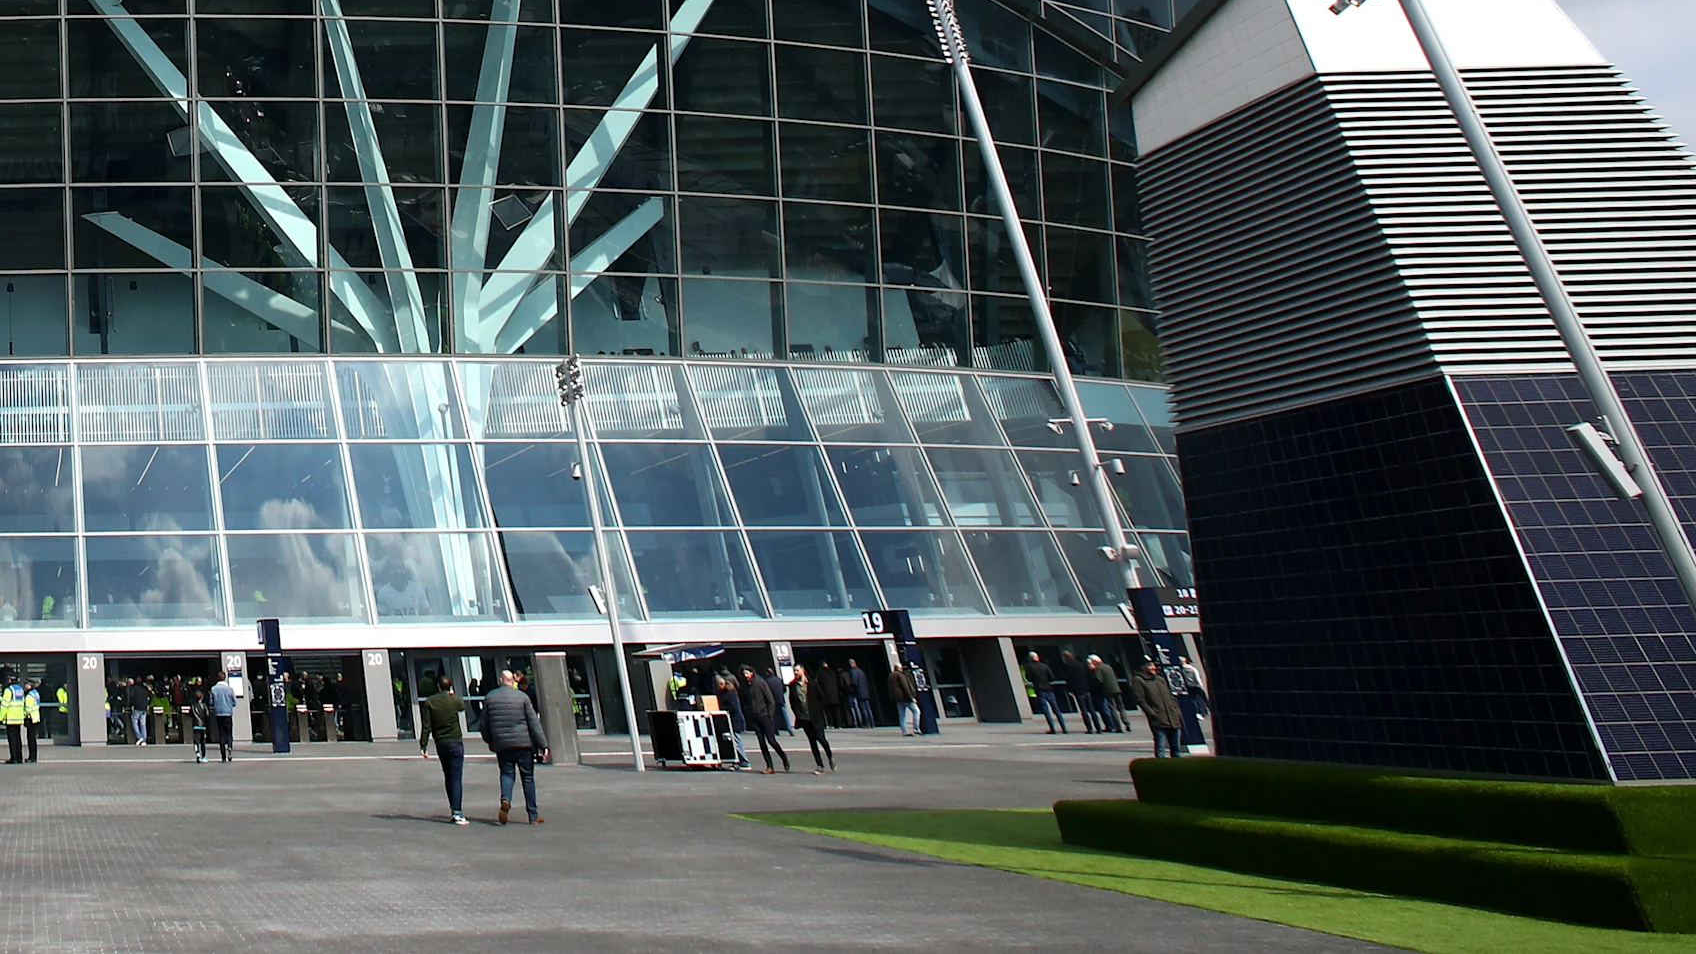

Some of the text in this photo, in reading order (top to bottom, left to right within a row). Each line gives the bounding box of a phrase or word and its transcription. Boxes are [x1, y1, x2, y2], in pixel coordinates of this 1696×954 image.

[863, 612, 884, 633] 19
[776, 645, 789, 657] 19
[83, 657, 97, 669] 20
[227, 656, 241, 668] 20
[368, 653, 383, 666] 20
